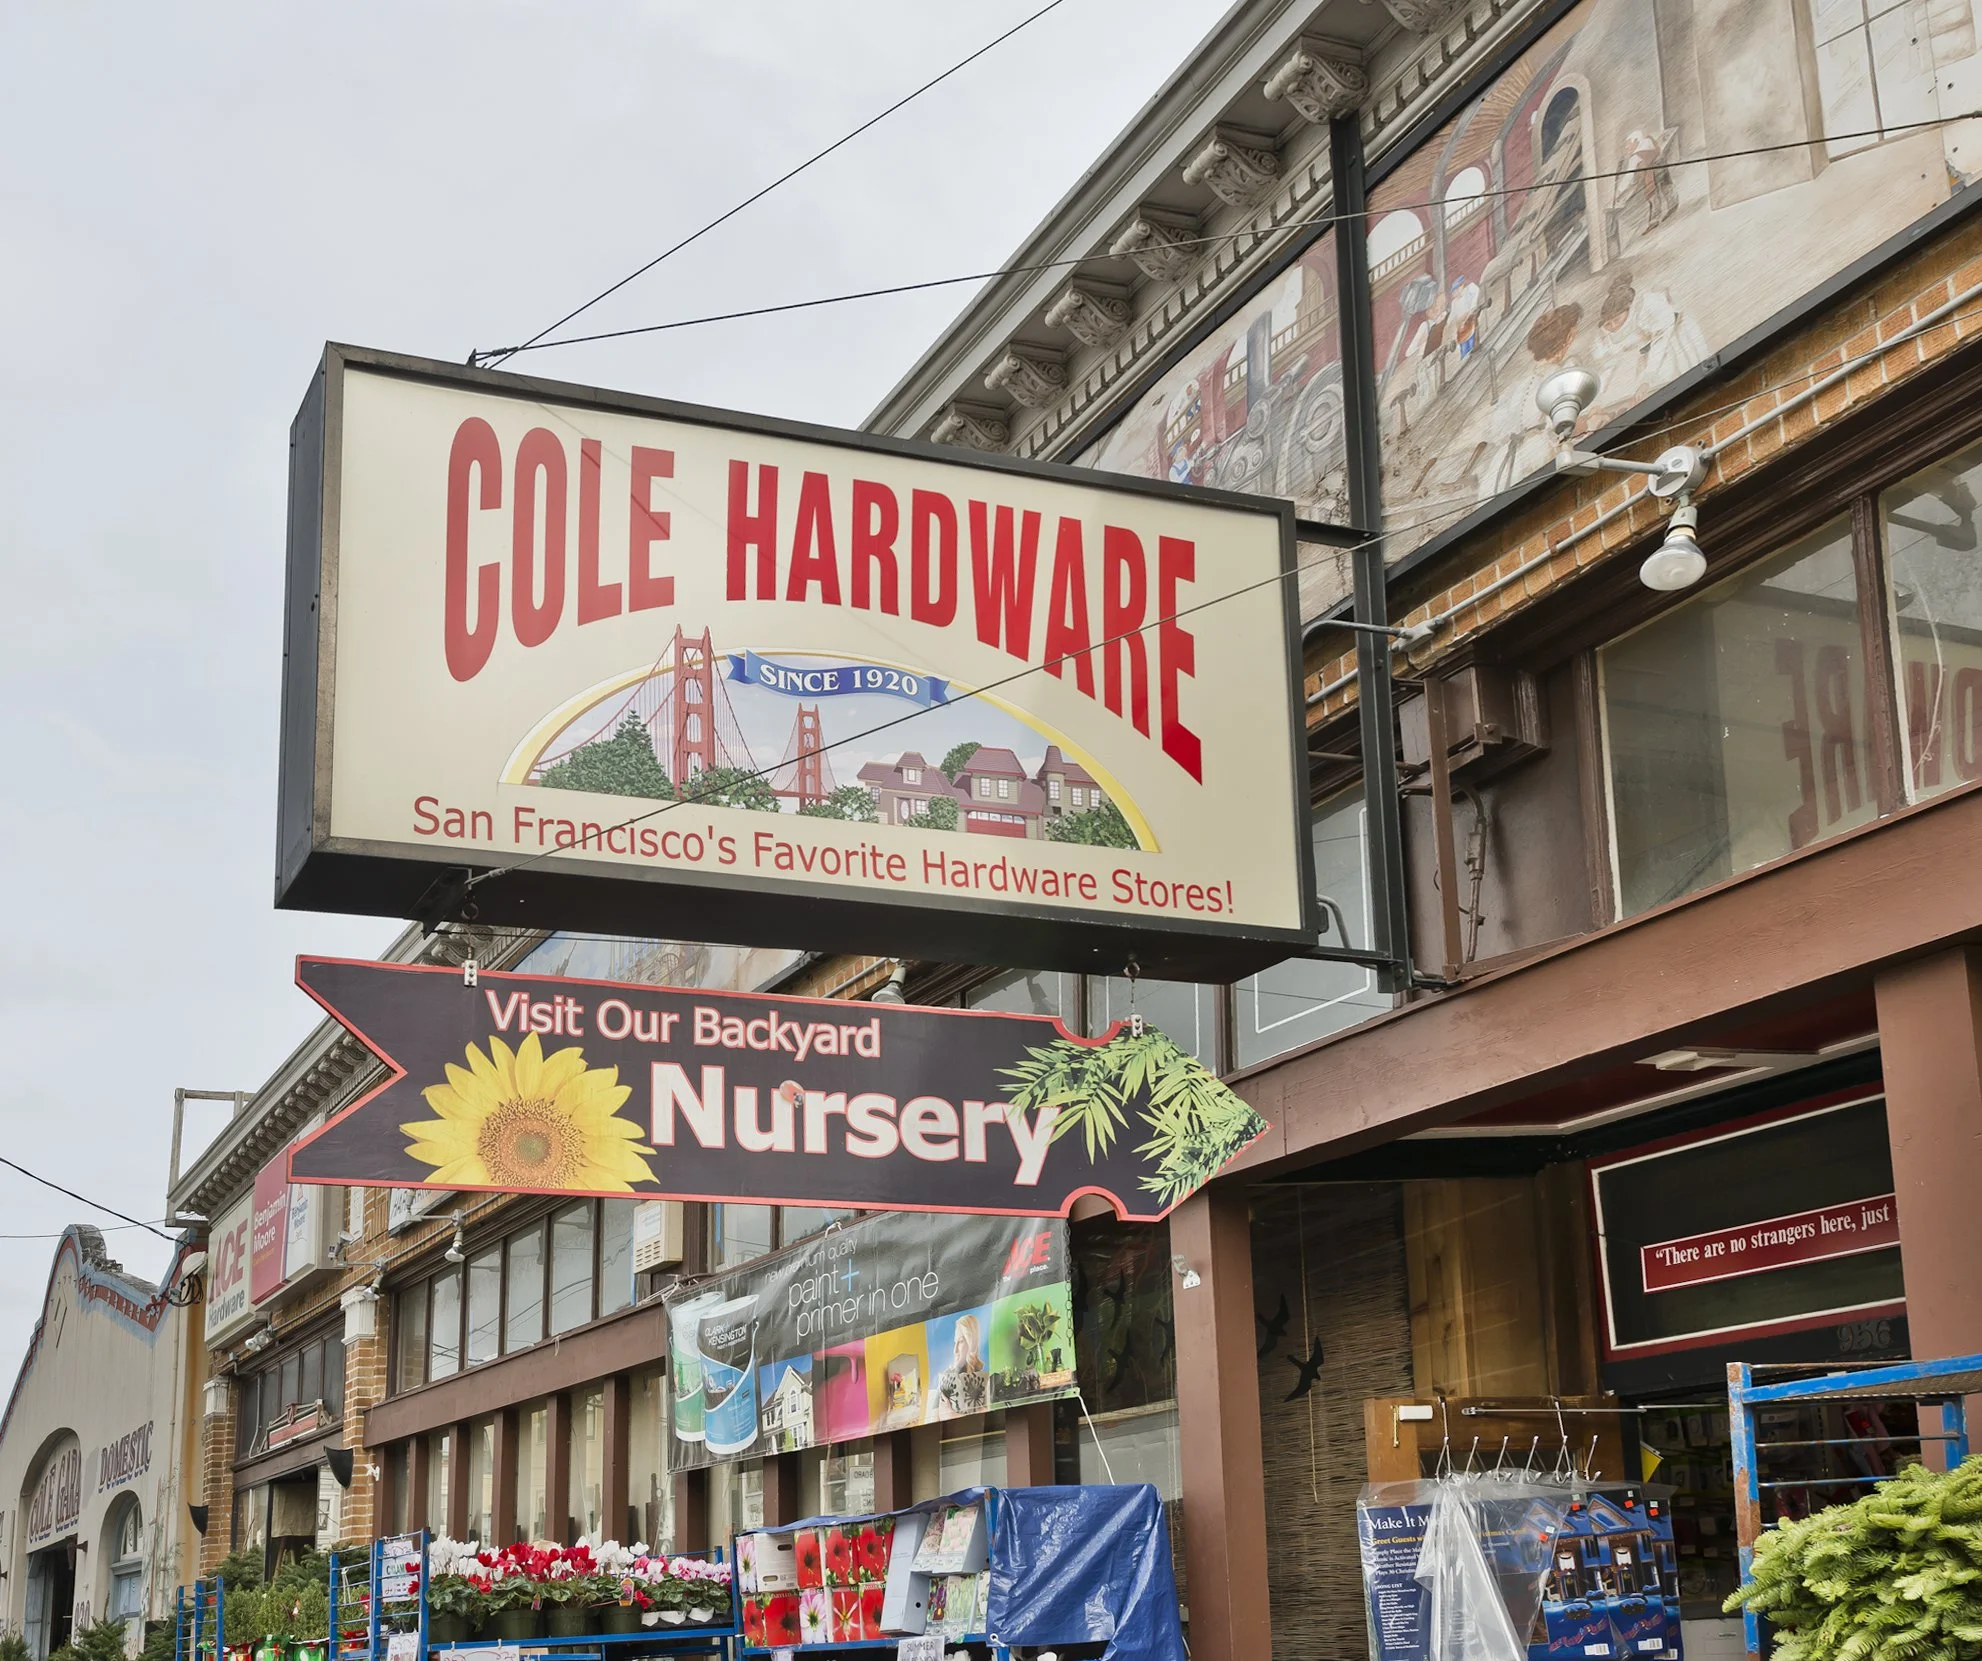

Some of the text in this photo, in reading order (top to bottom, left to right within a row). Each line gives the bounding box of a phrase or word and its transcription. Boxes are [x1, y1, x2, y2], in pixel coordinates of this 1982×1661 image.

[445, 417, 1203, 786] COLE HARDWARE
[760, 664, 918, 696] SINCE 1920
[413, 795, 1235, 915] San Francisco's Favorite Hardware Stores!
[485, 989, 882, 1062] Visit Our Backyard
[650, 1061, 1061, 1187] Nursery
[254, 1191, 287, 1230] Benjamin
[1704, 1242, 1725, 1259] are
[1730, 1237, 1747, 1254] no
[1751, 1221, 1816, 1250] strangers
[1820, 1214, 1857, 1235] here,
[1861, 1203, 1890, 1231] just
[208, 1217, 249, 1304] ACE
[253, 1225, 276, 1254] Moore
[1003, 1231, 1052, 1278] ACE
[208, 1289, 245, 1328] Hardware
[705, 1323, 726, 1337] CLARK
[796, 1271, 939, 1345] primer in one
[708, 1324, 748, 1346] KENSINGTON
[99, 1420, 153, 1493] DOMESTIC
[28, 1463, 56, 1544] COLE
[1371, 1516, 1402, 1530] Make
[1405, 1516, 1415, 1528] It
[1391, 1536, 1416, 1544] Guests
